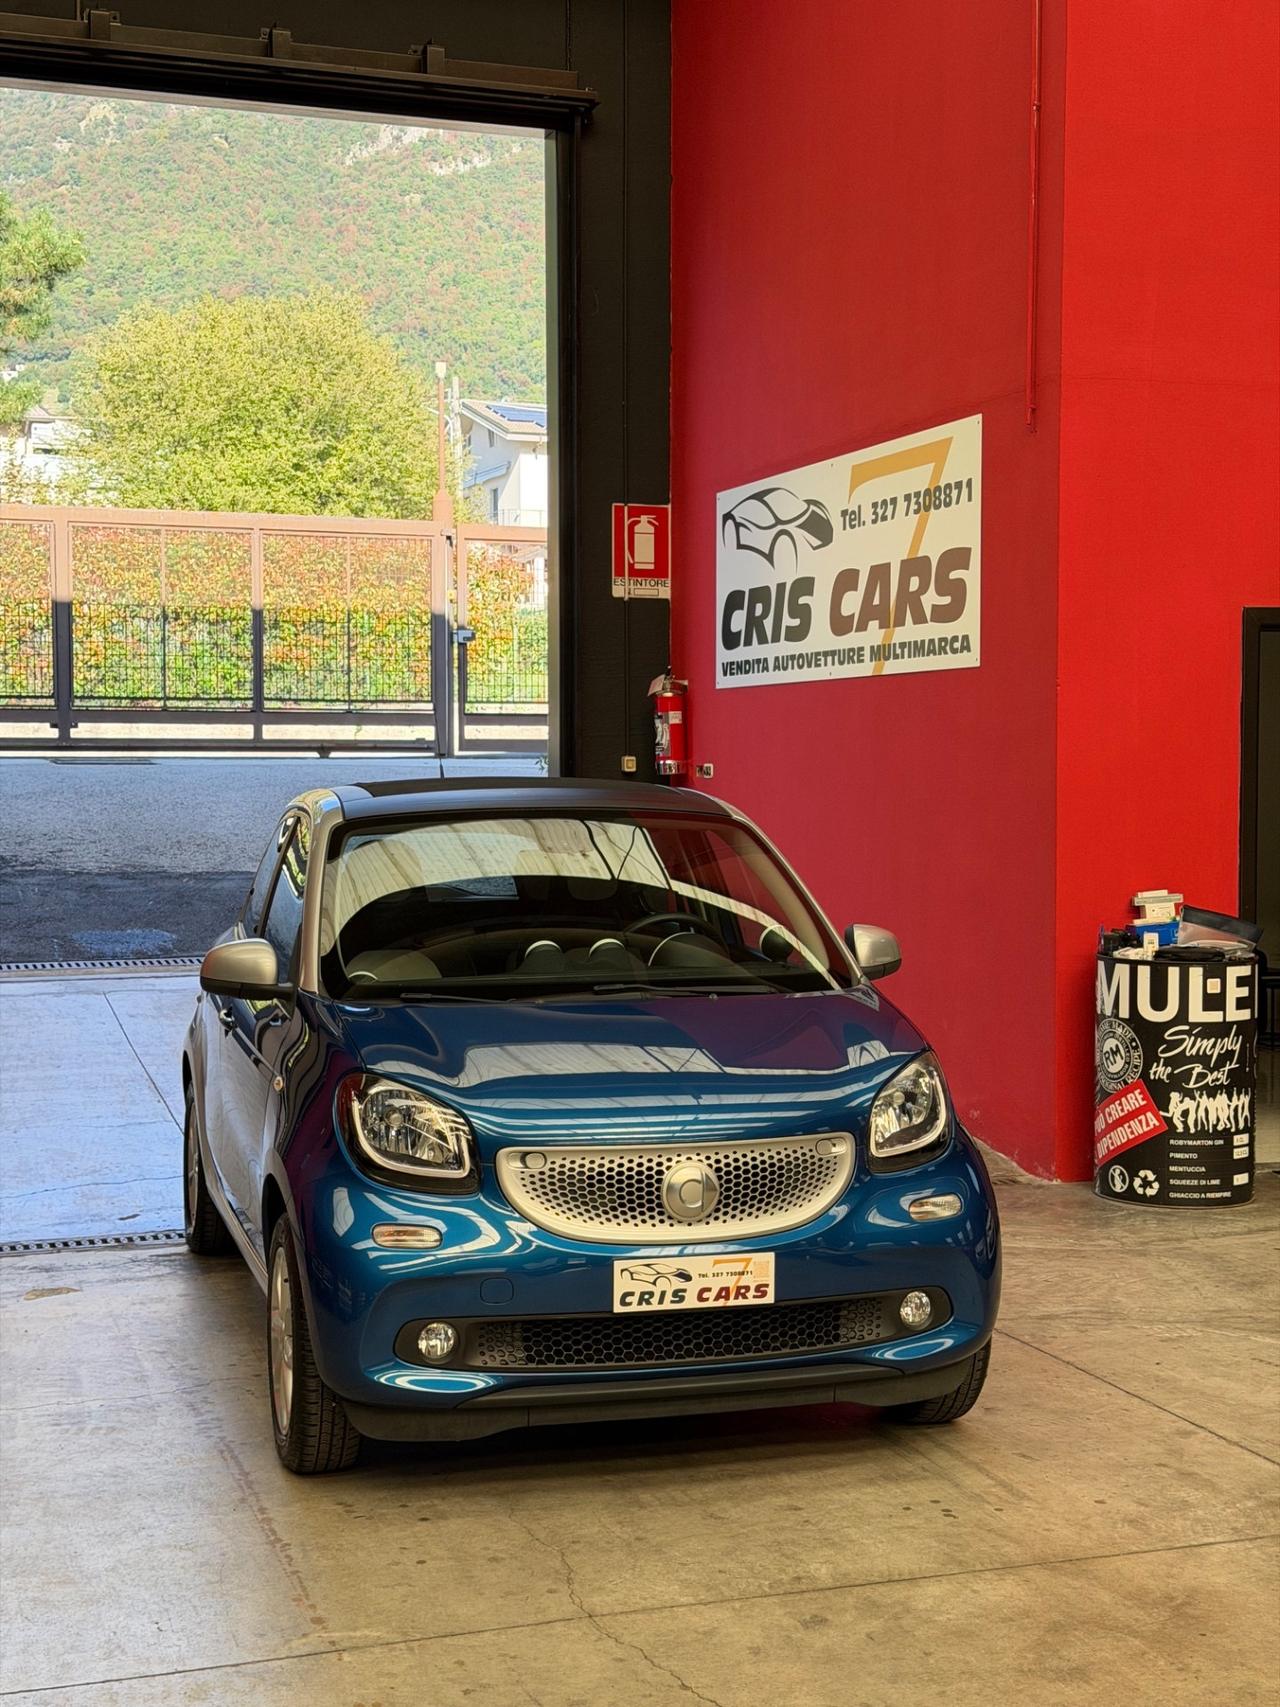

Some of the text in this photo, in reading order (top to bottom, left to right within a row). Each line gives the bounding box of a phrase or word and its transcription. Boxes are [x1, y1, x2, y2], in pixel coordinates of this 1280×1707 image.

[840, 477, 973, 531] Tel. 327 7308871
[613, 578, 669, 588] ESTINTORE
[721, 547, 972, 651] CRIS CARS
[721, 634, 972, 677] VENDITA AUTOVETTURE MULTIMARCA
[1096, 960, 1252, 1023] MULE
[1104, 1043, 1124, 1069] RM
[1158, 1024, 1243, 1067] Simply
[1149, 1058, 1240, 1088] the Best
[1104, 1088, 1147, 1123] CREARE
[1096, 1111, 1160, 1158] DIPENDENZA
[619, 1283, 770, 1307] CRIS CARS
